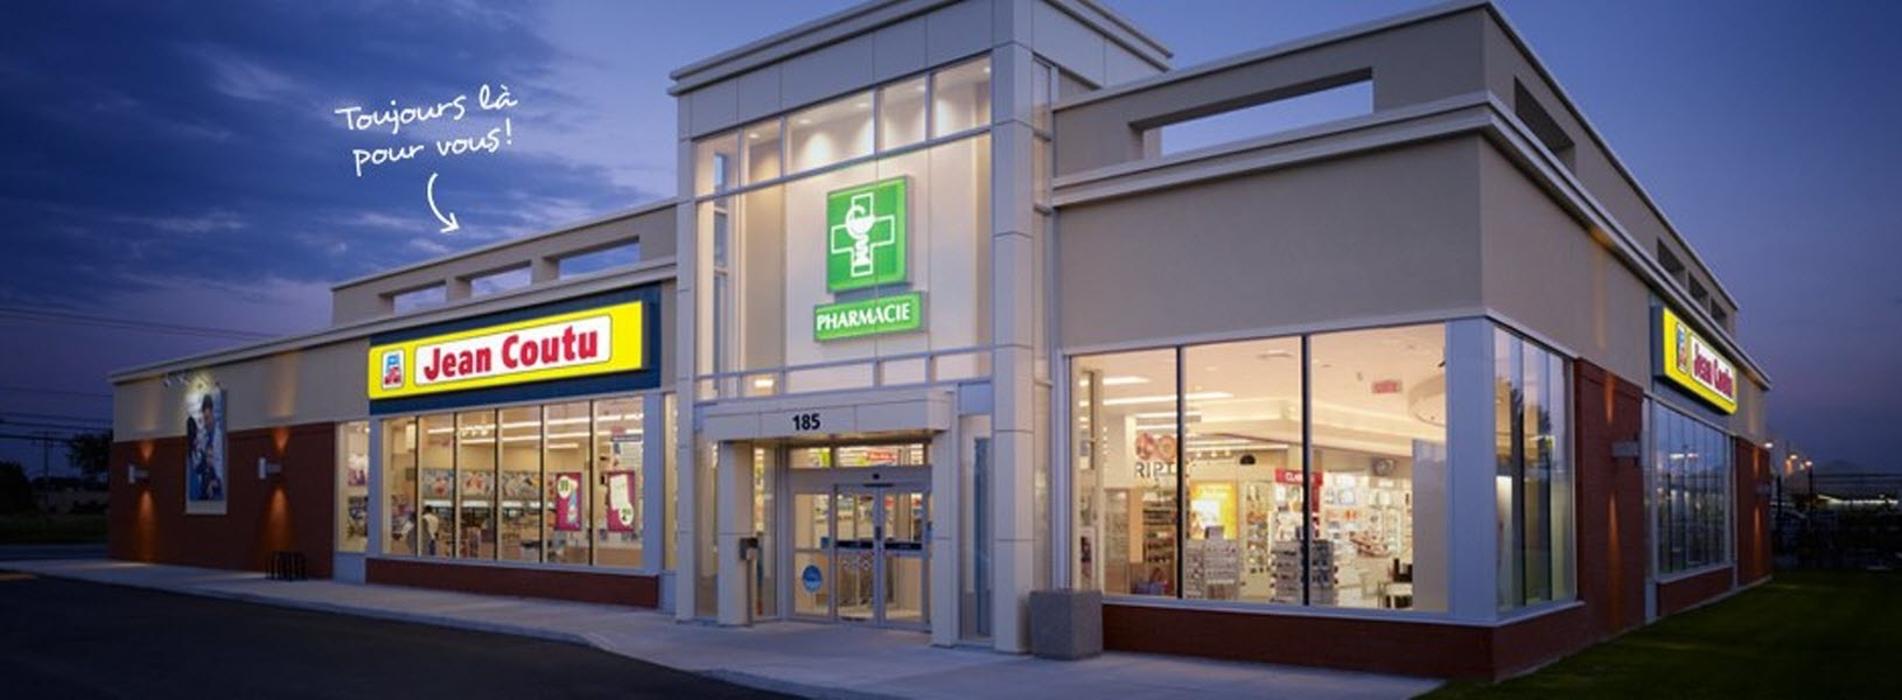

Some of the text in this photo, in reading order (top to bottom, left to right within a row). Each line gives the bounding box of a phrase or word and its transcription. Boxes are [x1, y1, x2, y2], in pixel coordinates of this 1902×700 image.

[815, 302, 911, 332] PHARMACIE
[423, 347, 493, 381] Jean
[501, 325, 598, 369] Coutu
[792, 413, 821, 431] 185
